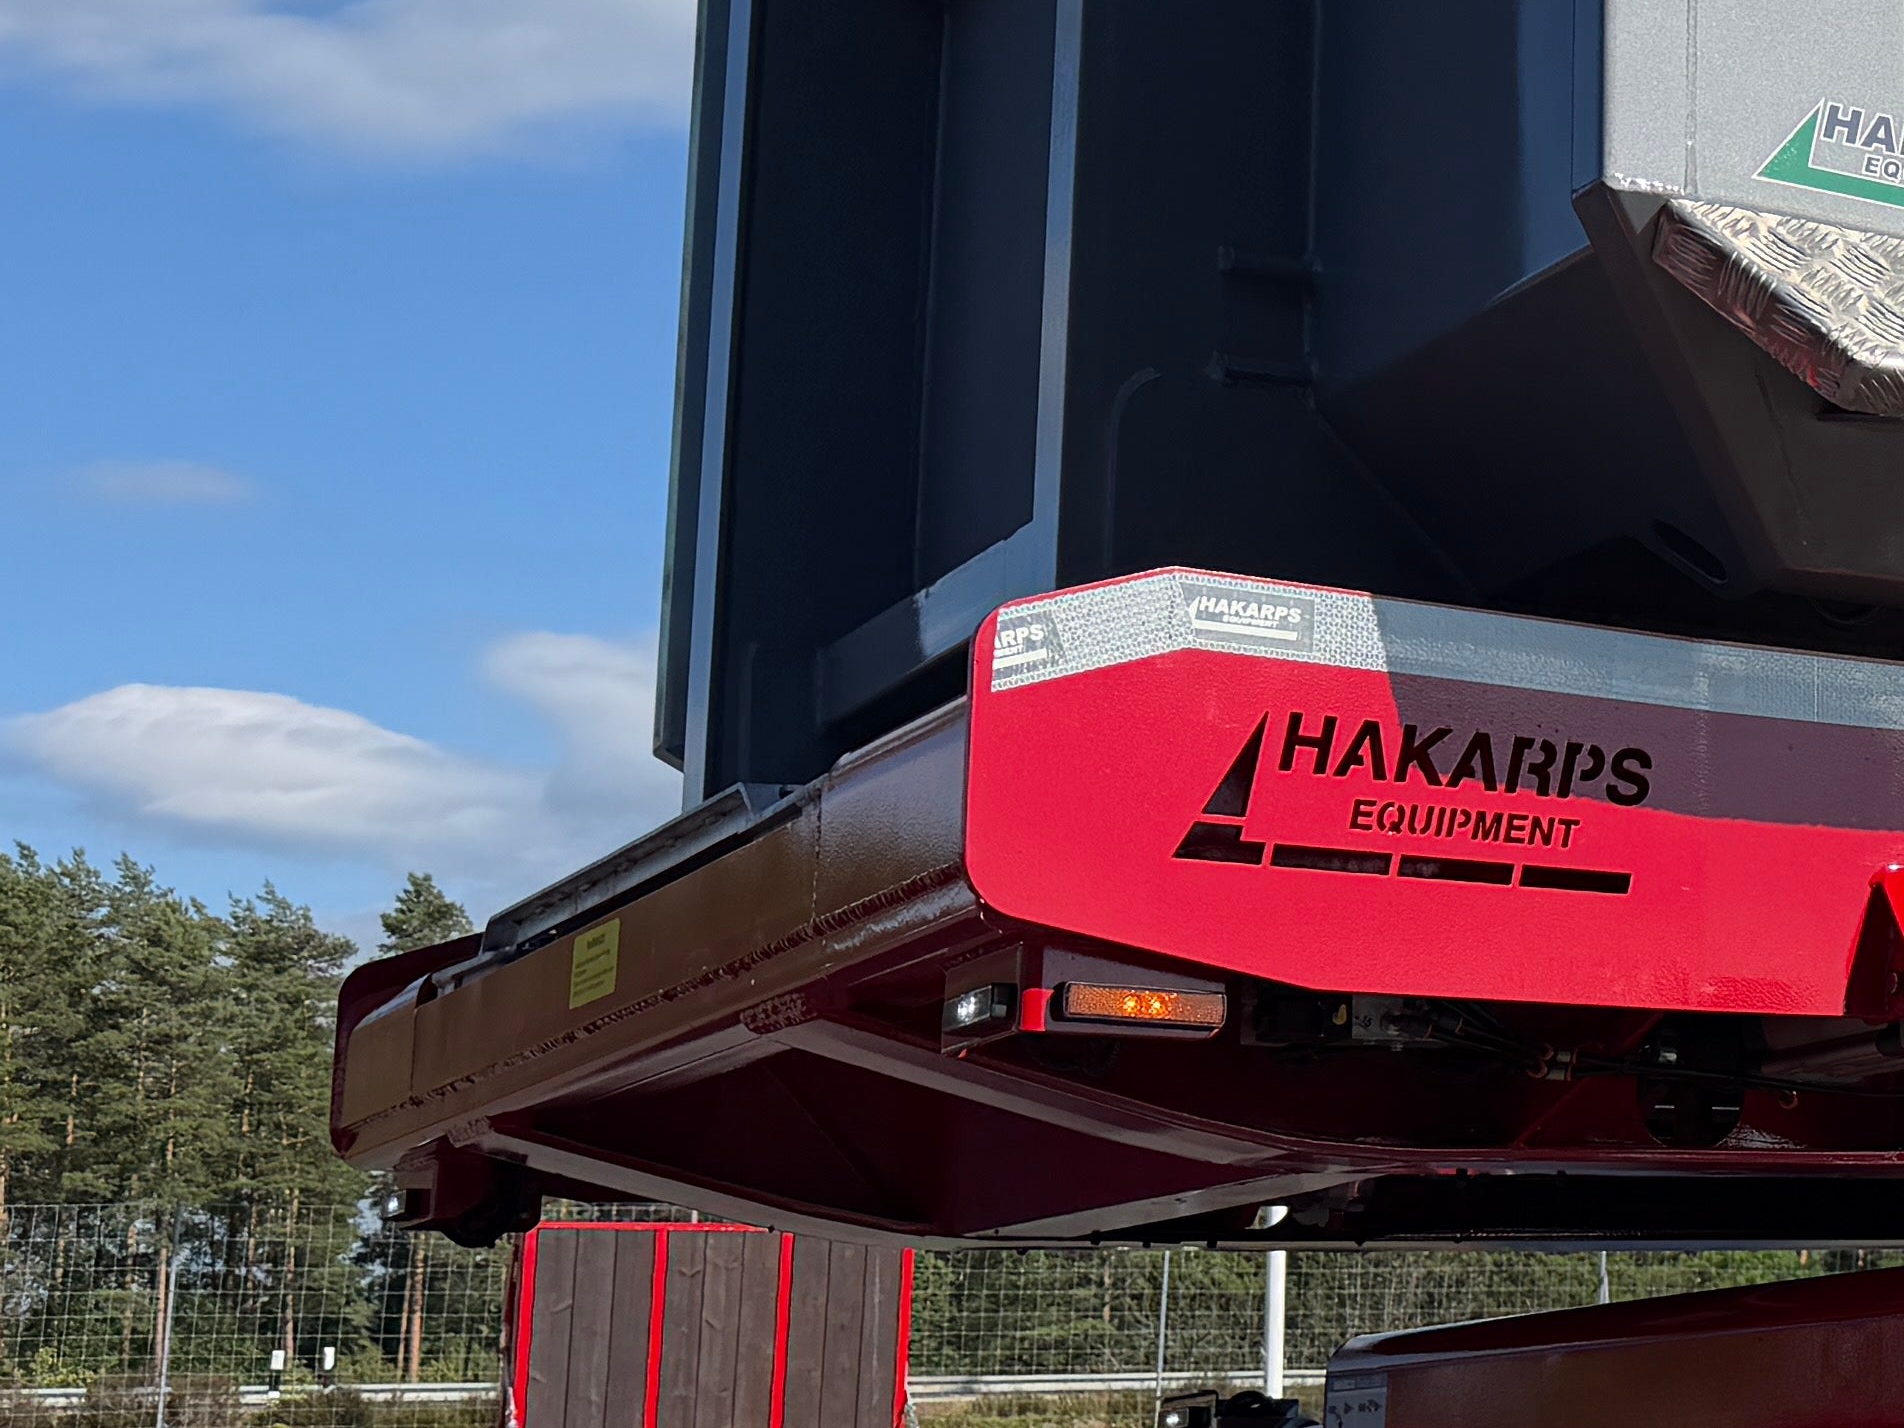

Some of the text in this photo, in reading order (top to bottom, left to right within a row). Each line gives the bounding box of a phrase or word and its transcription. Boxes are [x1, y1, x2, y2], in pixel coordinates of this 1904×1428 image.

[1199, 595, 1302, 623] HAKARPS
[1279, 712, 1653, 807] HAKARPS
[1349, 798, 1580, 848] EQUIPMENT
